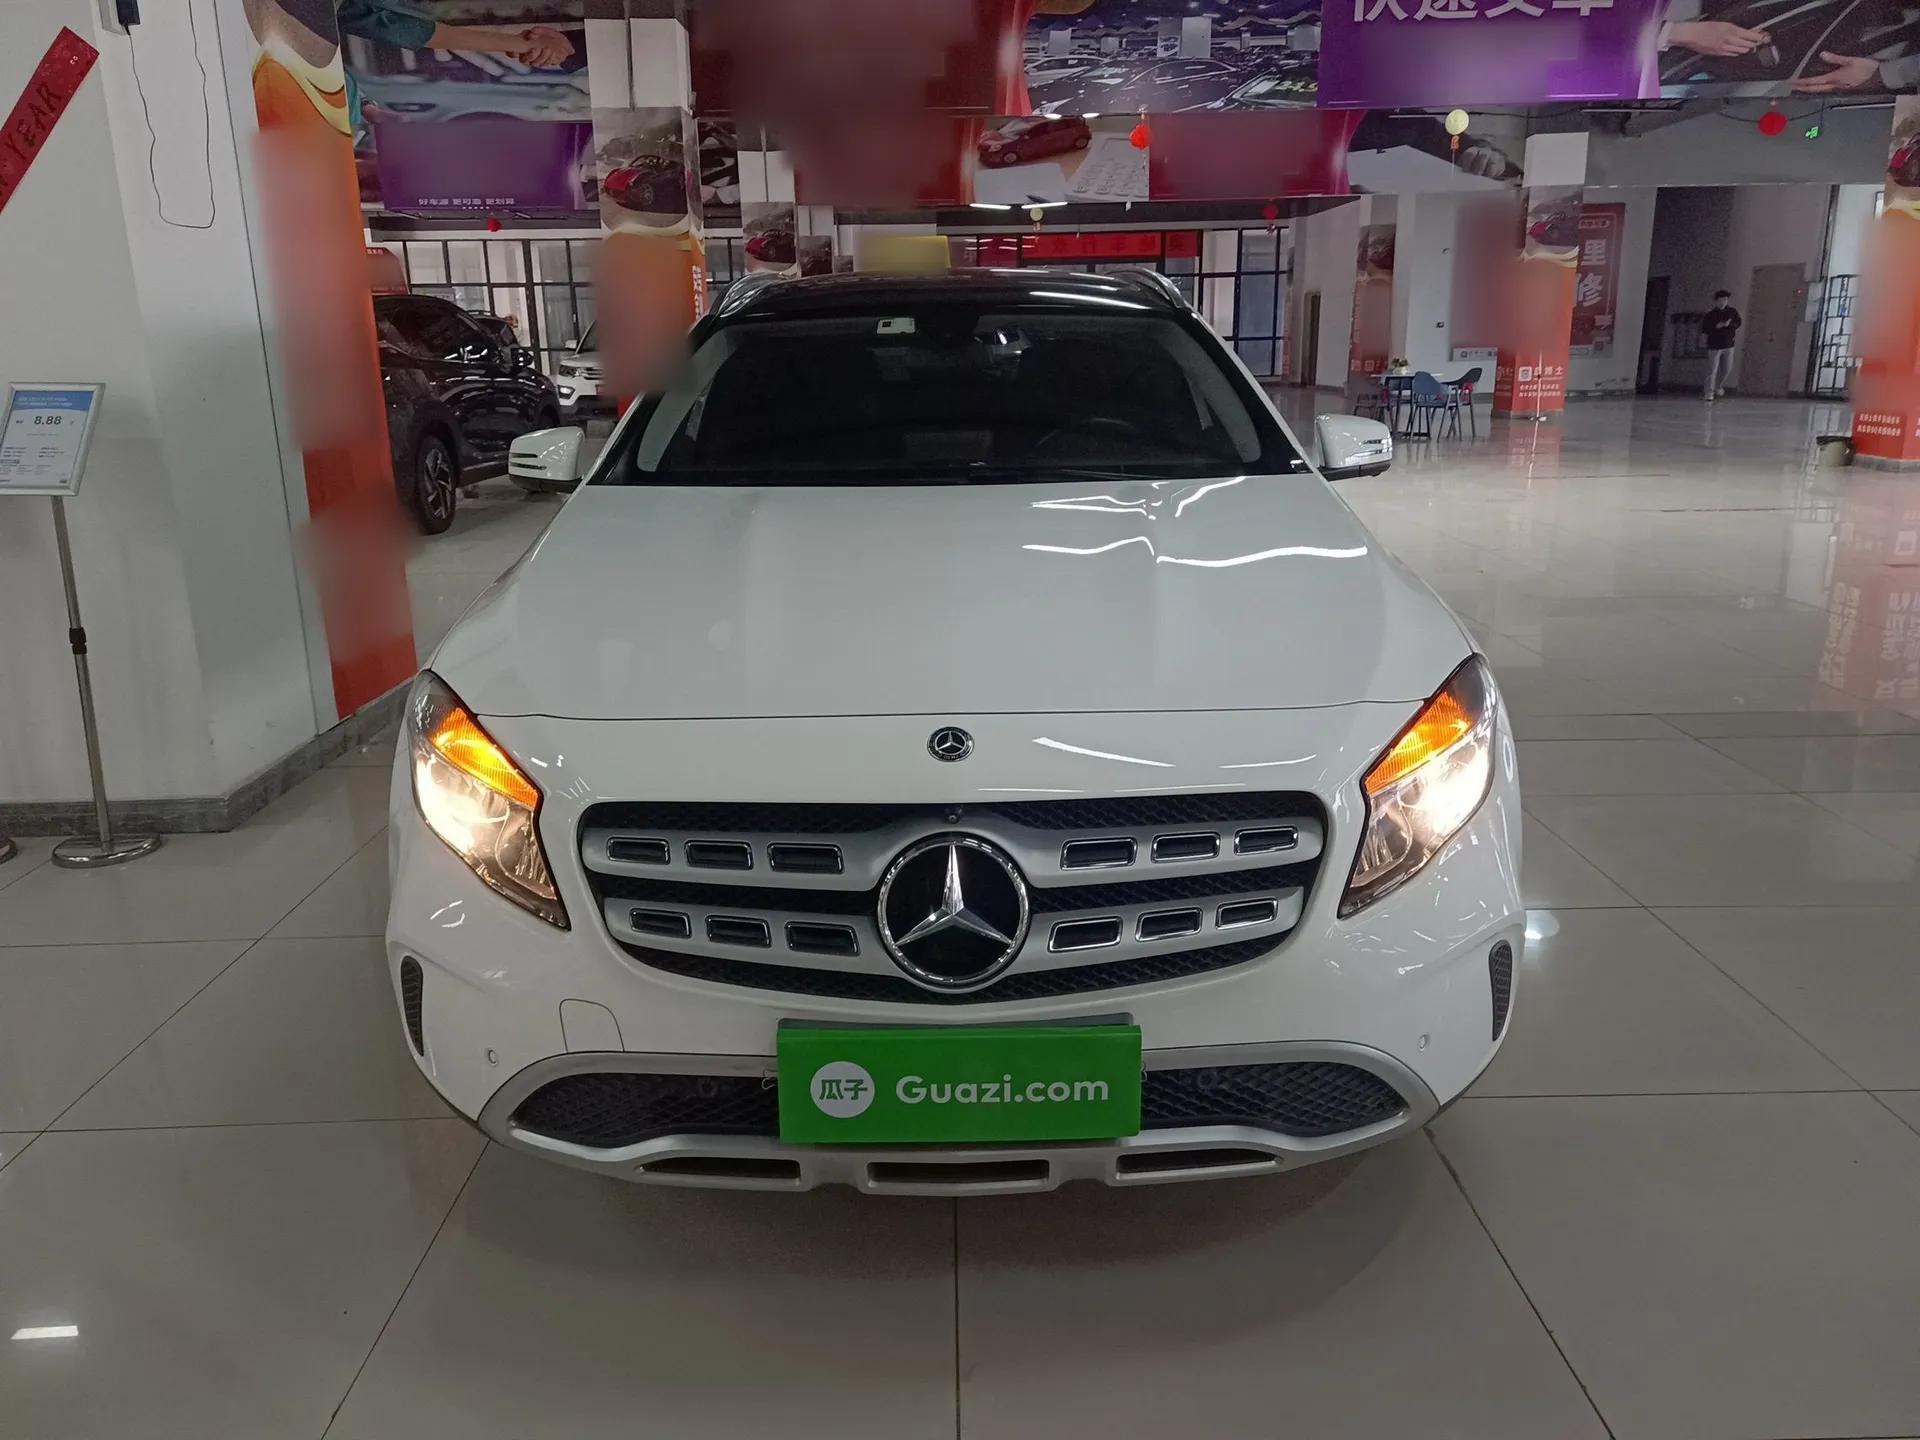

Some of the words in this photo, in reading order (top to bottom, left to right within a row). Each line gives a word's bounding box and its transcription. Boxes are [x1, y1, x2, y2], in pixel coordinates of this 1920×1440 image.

[34, 415, 62, 425] 8.88
[819, 1079, 868, 1101] 瓜子
[896, 1074, 1109, 1104] Guazi.com
